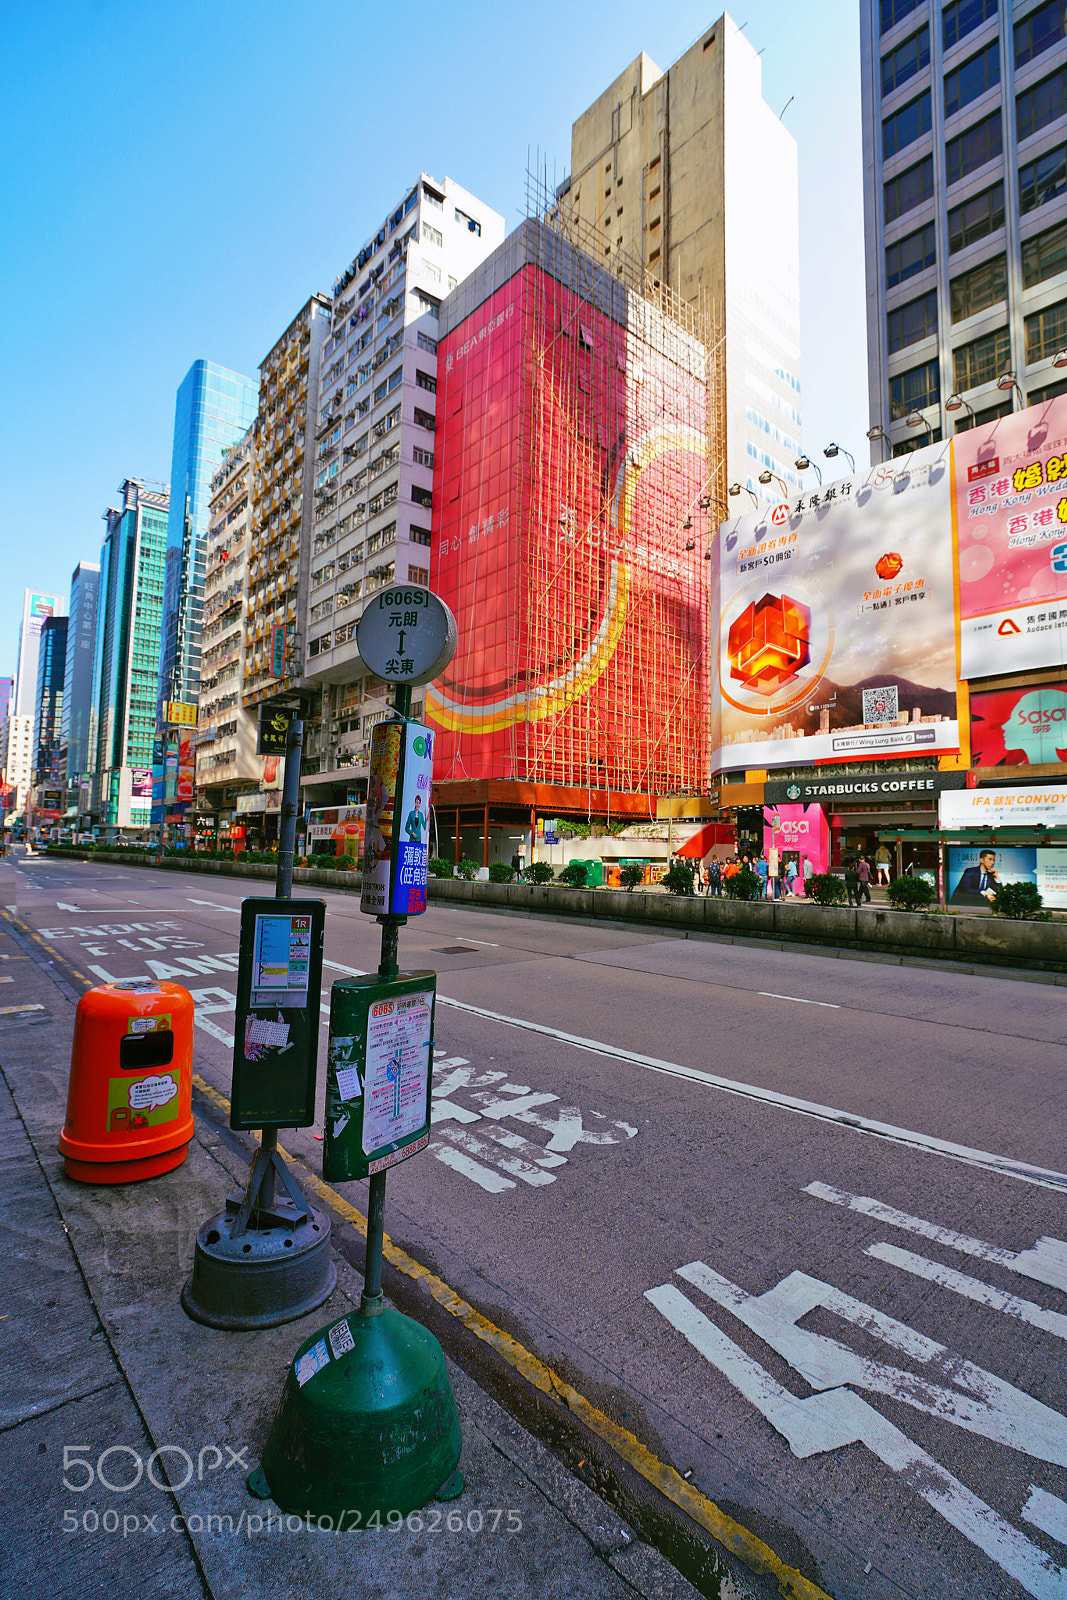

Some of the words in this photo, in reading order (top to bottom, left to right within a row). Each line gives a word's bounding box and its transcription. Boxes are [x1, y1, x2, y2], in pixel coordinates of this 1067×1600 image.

[456, 336, 478, 360] BEA
[794, 482, 853, 513] 永隆銀行
[969, 502, 998, 517] Hong
[1002, 492, 1032, 507] Kong
[440, 535, 461, 556] 同心
[1009, 534, 1037, 548] Hong
[1040, 526, 1067, 541] Kong
[379, 591, 430, 609] [606S]
[388, 611, 418, 628] 元朗
[385, 659, 415, 674] 尖東
[859, 738, 874, 746] Wing
[875, 737, 890, 745] Lung
[805, 782, 878, 796] STARBUCKS
[881, 779, 935, 792] COFFEE
[972, 797, 991, 806] IFA
[1017, 793, 1067, 804] CONVOY
[775, 820, 809, 834] asa
[296, 918, 307, 928] 1R
[373, 1003, 393, 1017] 606S
